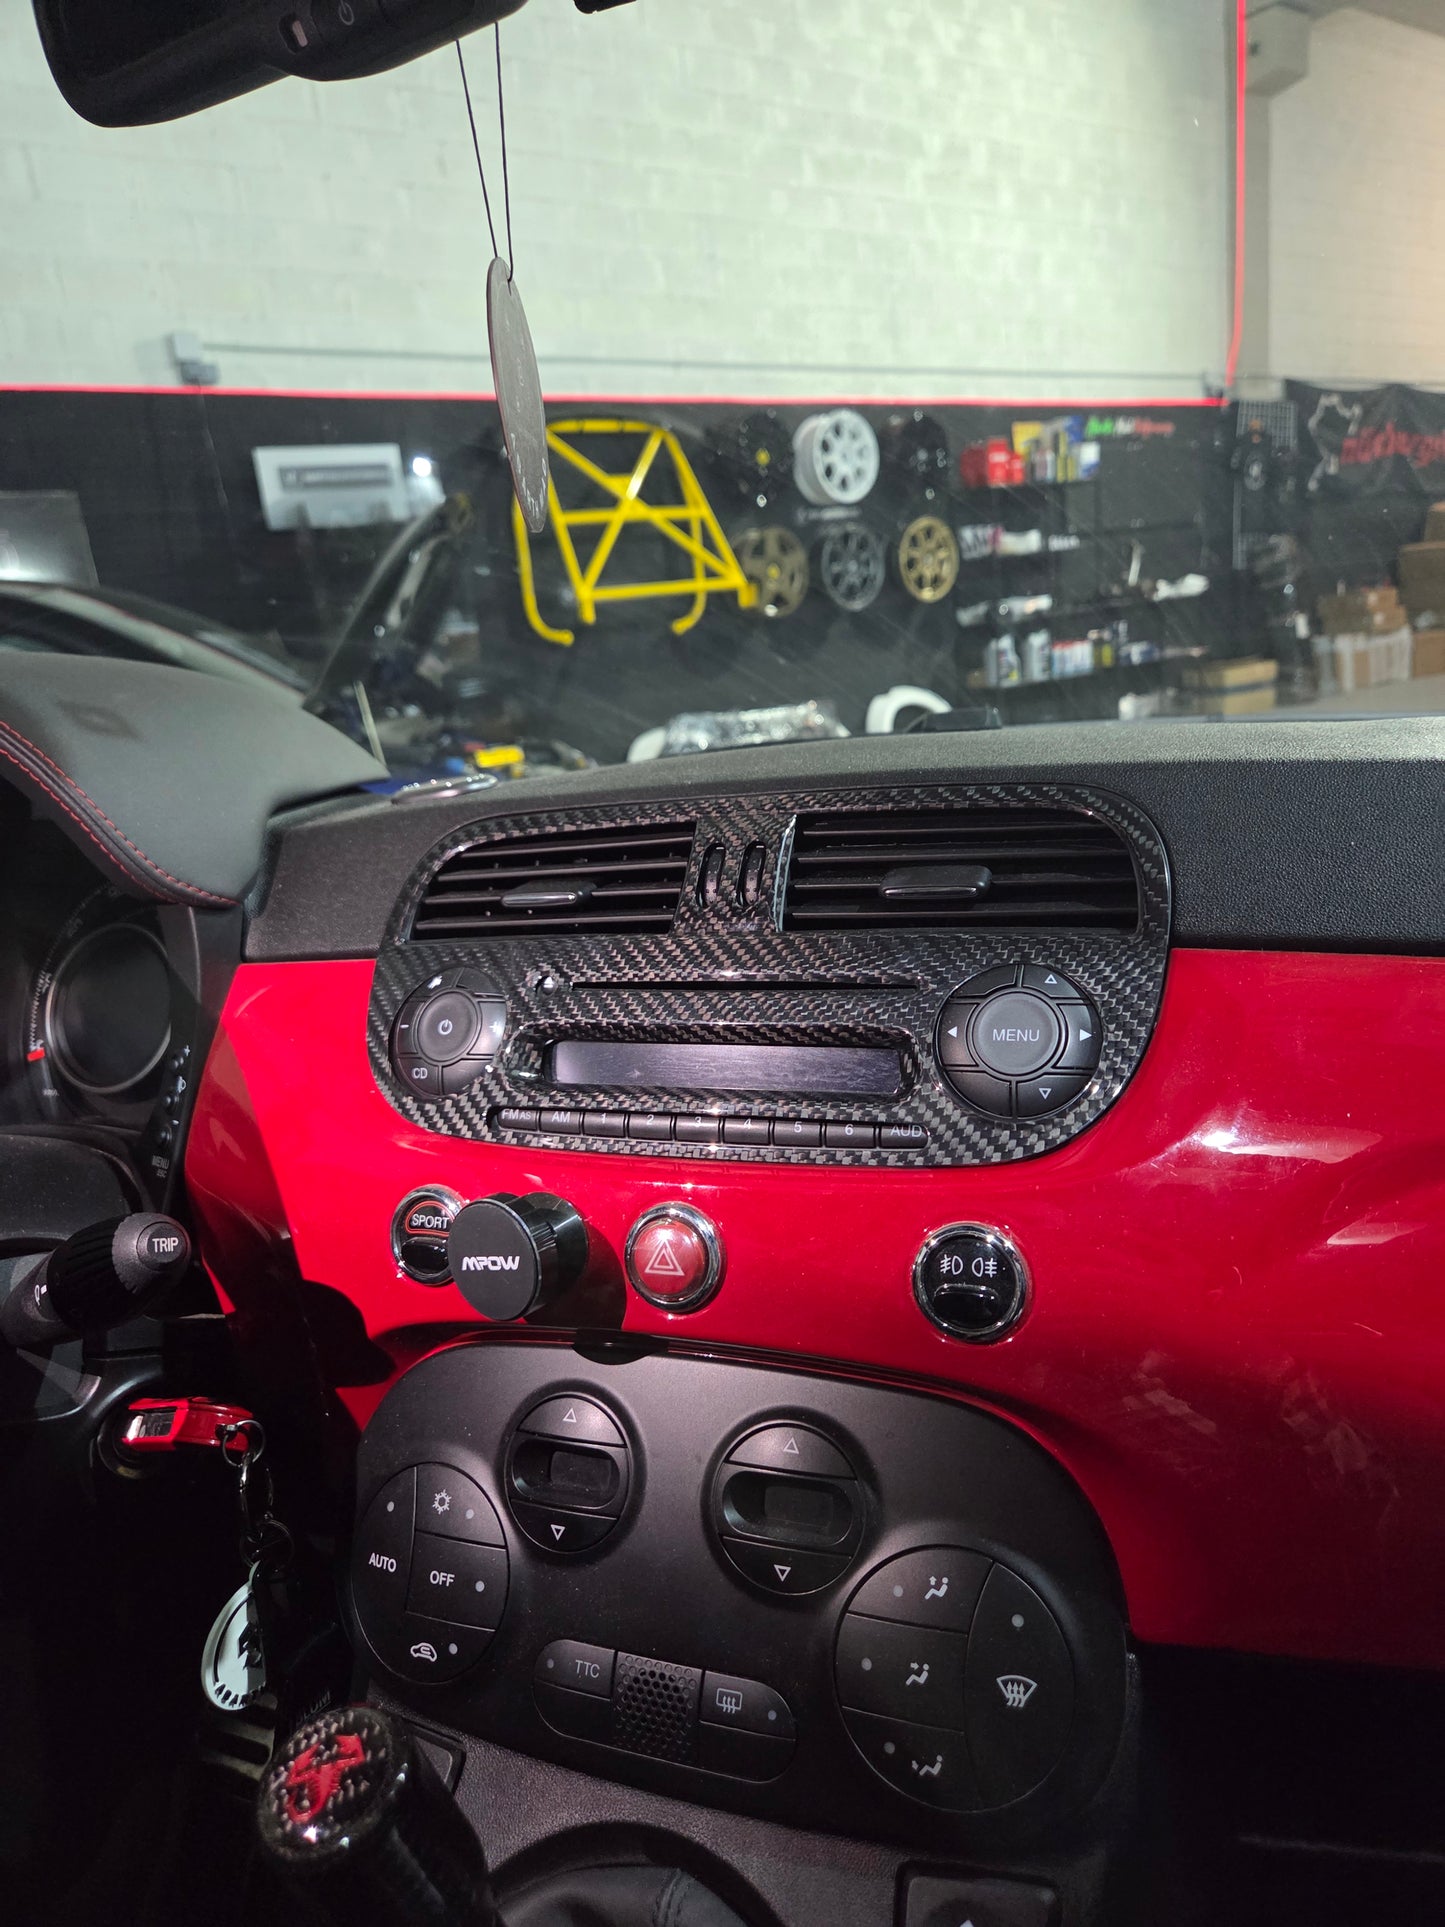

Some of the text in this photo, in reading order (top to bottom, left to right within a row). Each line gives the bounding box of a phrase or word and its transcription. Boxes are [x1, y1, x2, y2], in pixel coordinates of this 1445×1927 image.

[992, 1028, 1041, 1042] MENU
[411, 1067, 428, 1080] CD
[501, 1108, 519, 1120] FM
[551, 1110, 571, 1122] AM
[601, 1111, 607, 1123] 1
[646, 1113, 655, 1125] 2
[694, 1115, 702, 1127] 3
[743, 1117, 752, 1129] 4
[793, 1120, 803, 1132] 5
[845, 1123, 854, 1135] 6
[890, 1123, 923, 1137] AUD
[412, 1213, 449, 1230] SPORT
[152, 1237, 179, 1253] TRIP
[461, 1255, 520, 1271] MPOW
[368, 1552, 397, 1573] AUTO
[429, 1570, 455, 1587] OFF
[575, 1659, 601, 1679] TTC
